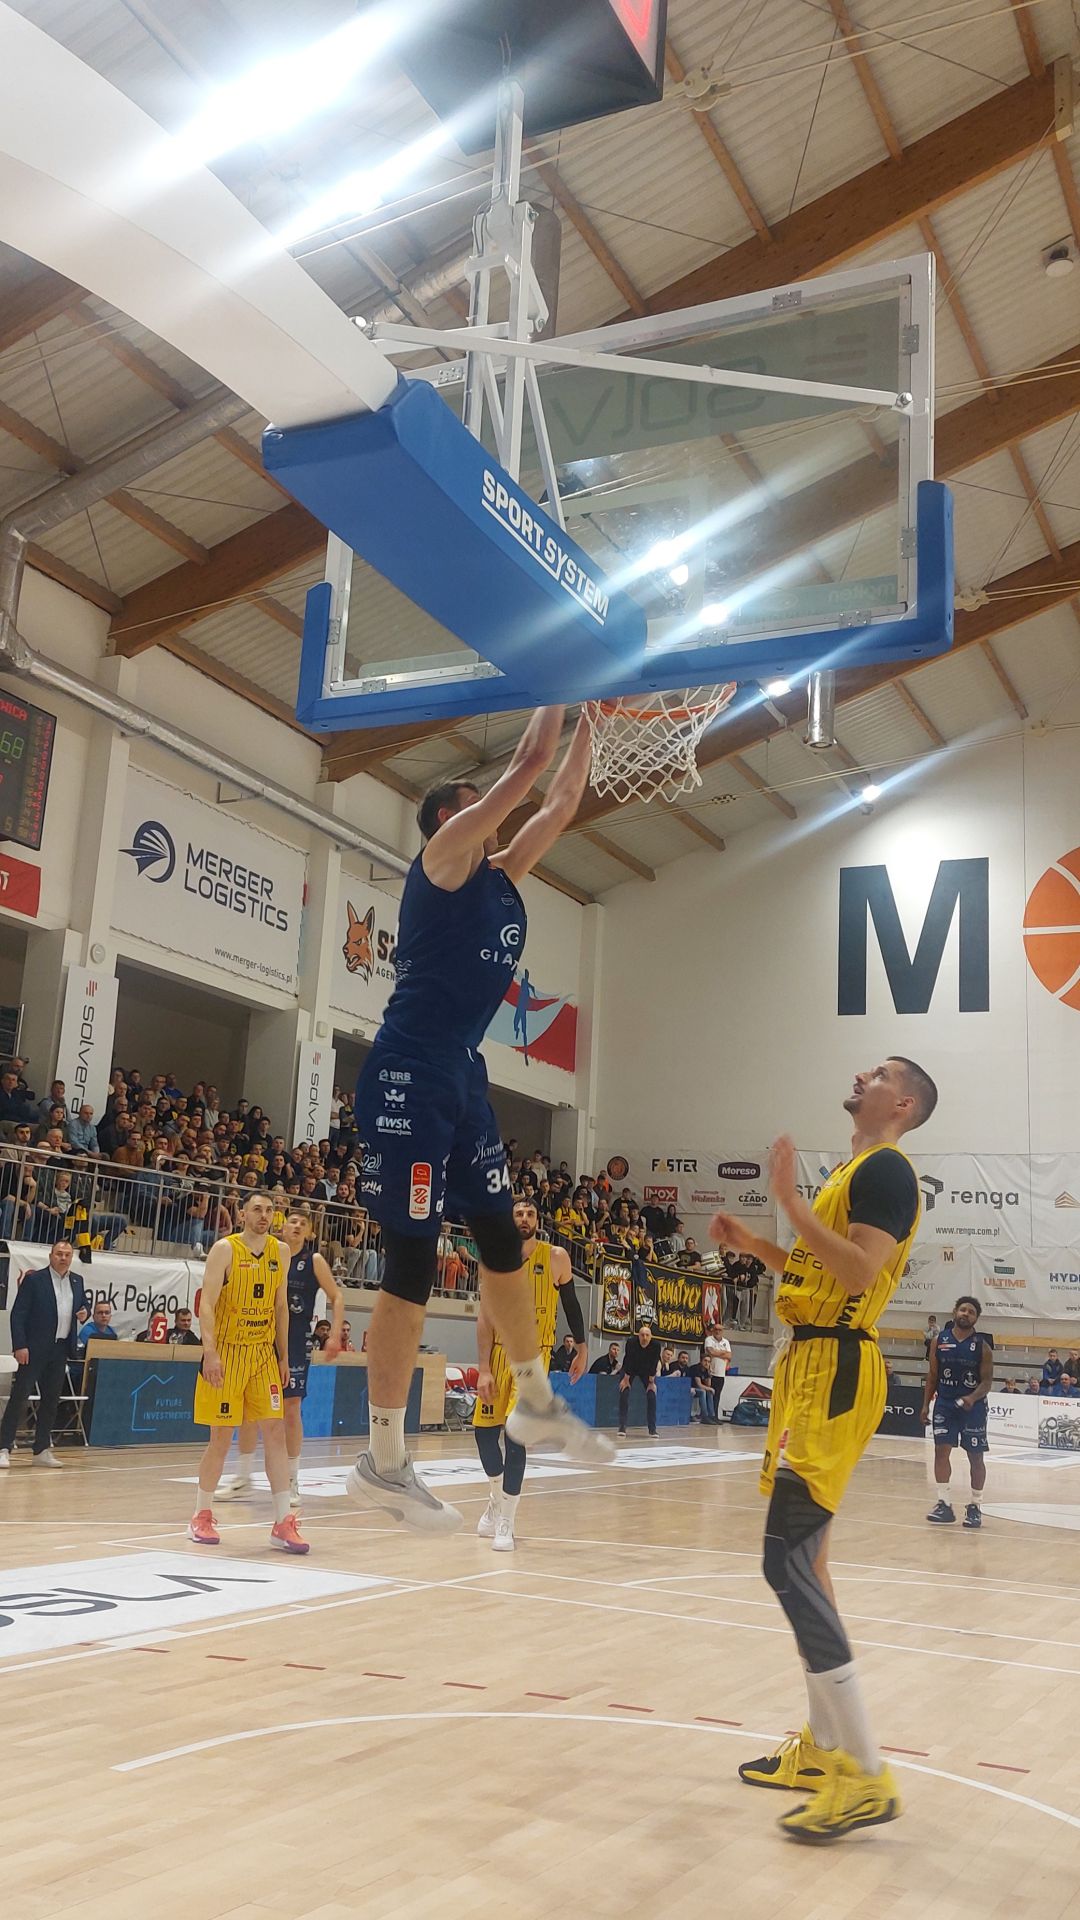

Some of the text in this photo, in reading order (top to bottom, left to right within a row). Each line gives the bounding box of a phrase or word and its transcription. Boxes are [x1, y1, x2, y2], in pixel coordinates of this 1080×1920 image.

[482, 468, 610, 618] SPORT SYSTEM
[186, 842, 274, 901] MERGER
[183, 868, 289, 932] LOGISTICS
[214, 947, 293, 984] www.merger-logistics.pl
[70, 1004, 96, 1119] solvera
[389, 1070, 412, 1082] URB
[384, 1118, 412, 1130] WSK
[651, 1158, 698, 1173] FASTER
[721, 1165, 757, 1176] Moreso
[486, 1163, 512, 1194] 34
[645, 1187, 676, 1200] INOX
[738, 1195, 768, 1204] CZADO
[951, 1190, 1020, 1210] renga
[935, 1226, 1001, 1237] www.renga.com.pl
[296, 1260, 305, 1271] 6
[252, 1282, 265, 1299] 8
[123, 1283, 179, 1316] Pekao
[154, 1321, 167, 1341] 5
[289, 1377, 296, 1389] 6
[143, 1408, 192, 1420] INVESTMENTS
[372, 1415, 390, 1427] 23
[971, 1436, 979, 1448] 9
